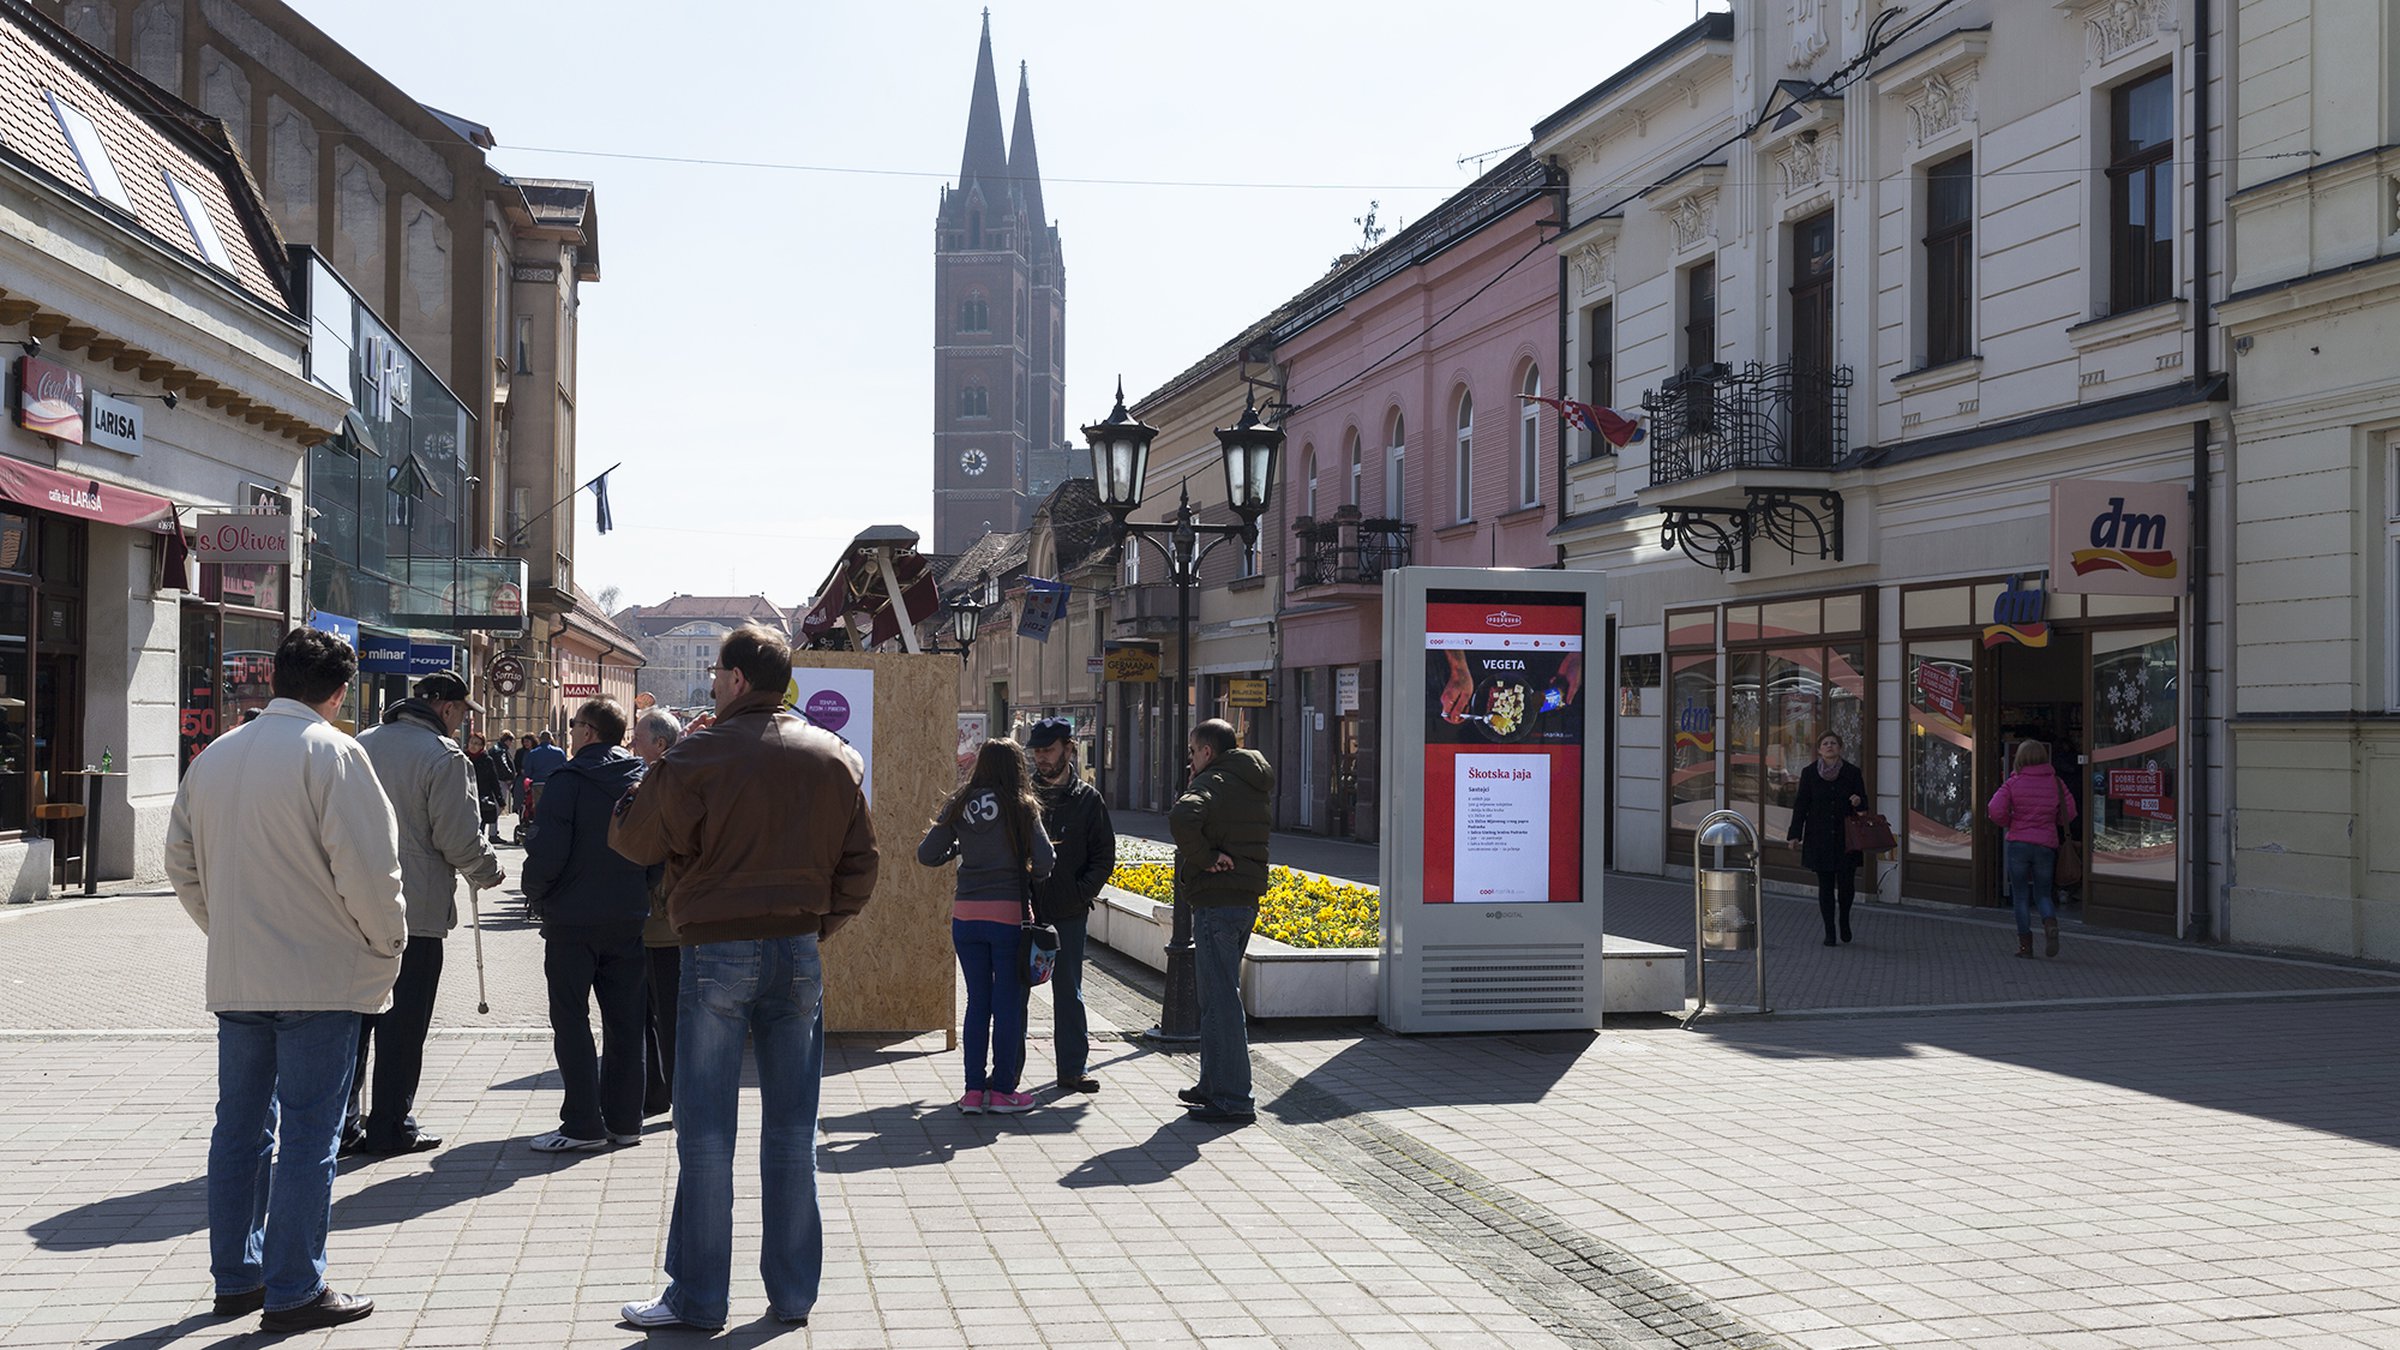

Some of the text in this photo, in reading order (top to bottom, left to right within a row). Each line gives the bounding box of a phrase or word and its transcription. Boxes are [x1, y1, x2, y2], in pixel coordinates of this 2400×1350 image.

[95, 407, 136, 440] LARISA
[71, 489, 102, 512] LARISA
[2090, 497, 2166, 550] dm
[200, 525, 286, 552] s.Oliver
[1994, 576, 2046, 623] dm
[1023, 622, 1046, 632] HDZ
[368, 648, 406, 660] mlinar
[1483, 660, 1525, 670] VEGETA
[493, 670, 522, 681] Sorriso
[565, 687, 597, 696] MANA
[1681, 696, 1709, 732] dm
[1468, 767, 1532, 781] Škotska jaja
[2114, 775, 2135, 783] DOBRE
